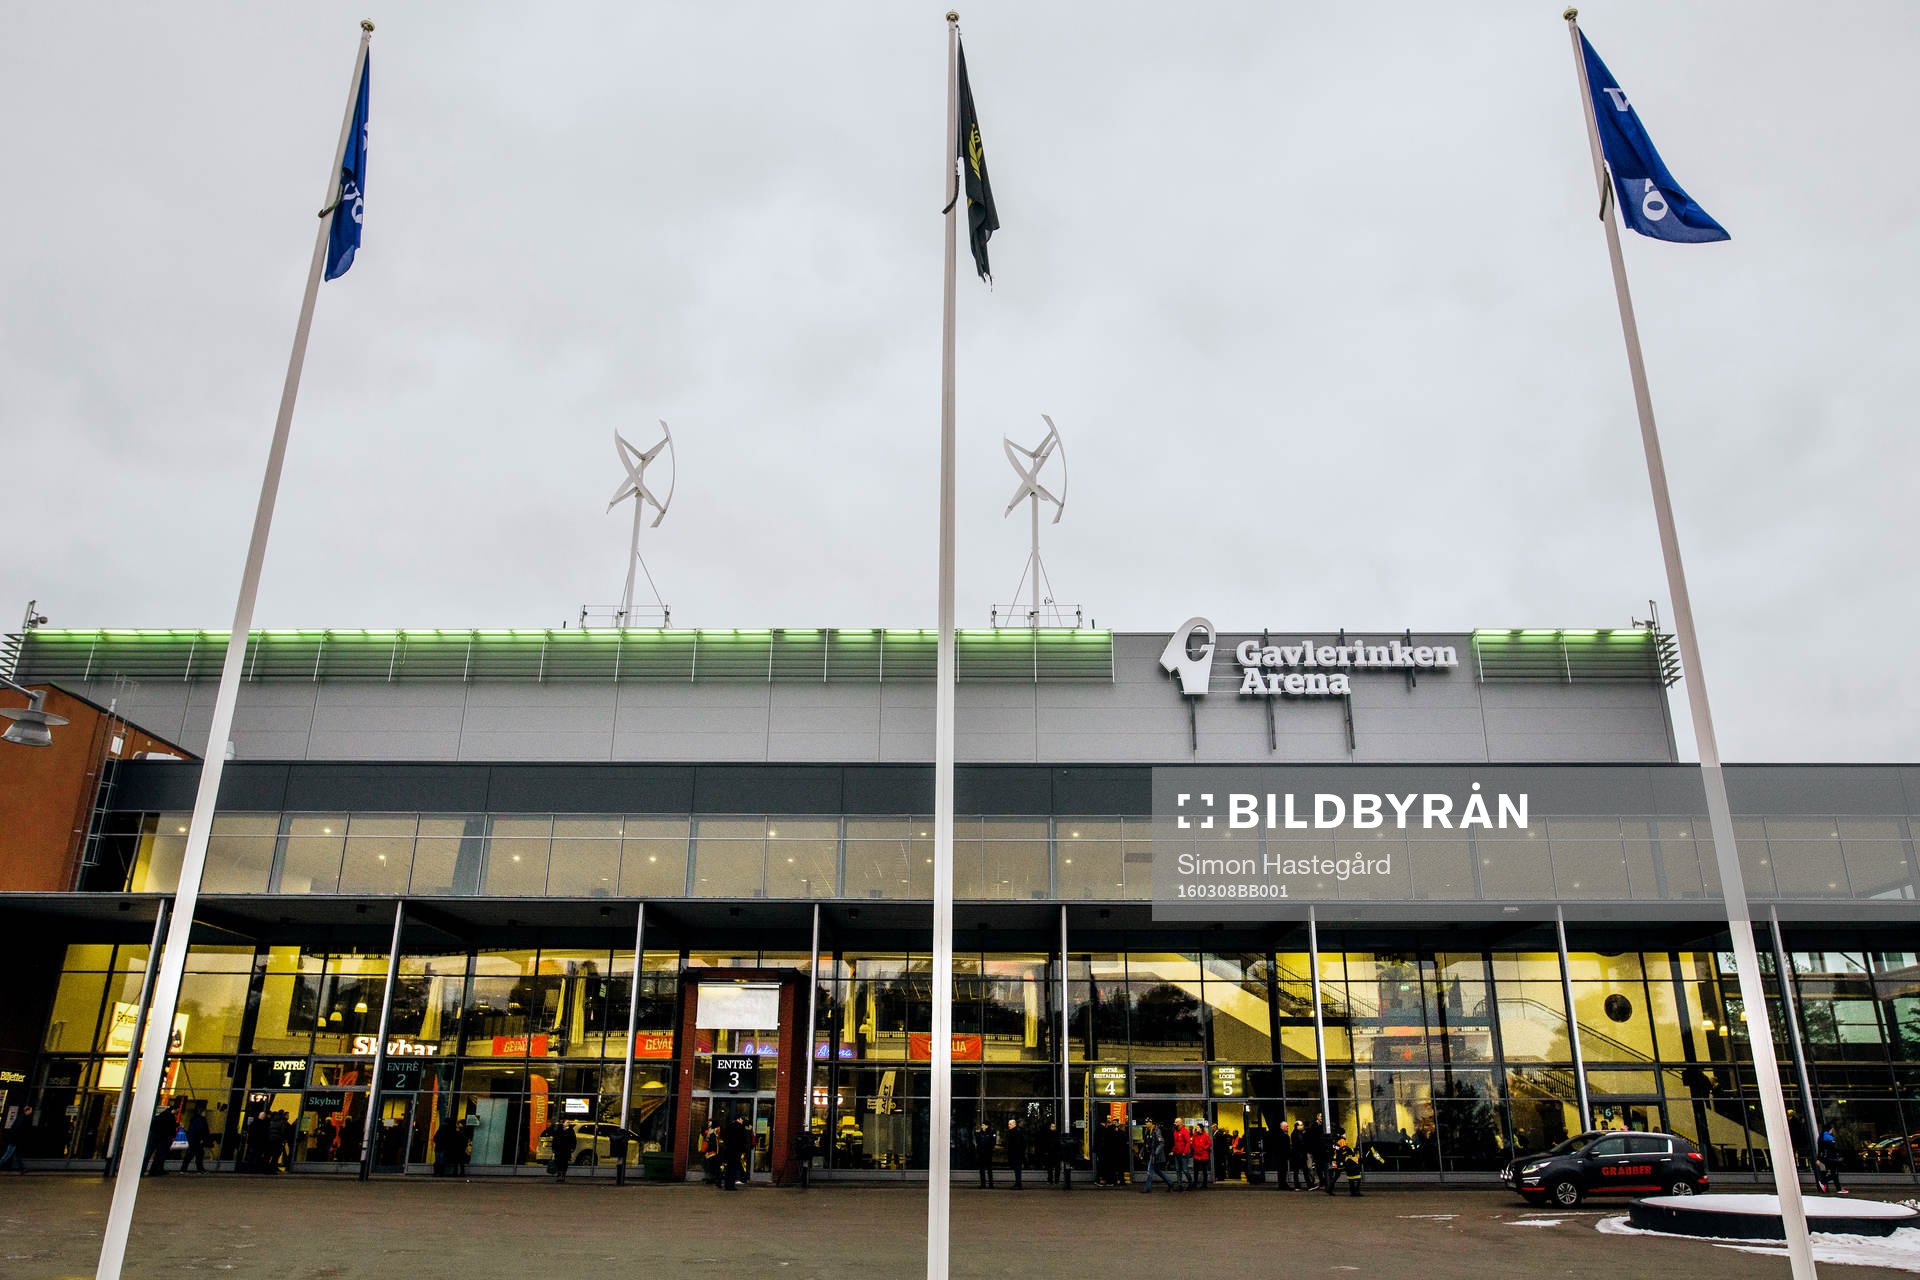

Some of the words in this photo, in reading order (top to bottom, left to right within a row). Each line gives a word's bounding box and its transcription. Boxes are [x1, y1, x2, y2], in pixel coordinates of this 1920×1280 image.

[1236, 640, 1459, 667] Gavlerinken
[1240, 668, 1351, 694] Arena
[645, 1038, 673, 1050] GEVAL
[817, 1044, 853, 1058] Arna
[282, 1071, 291, 1087] 1
[396, 1073, 406, 1088] 2
[728, 1072, 740, 1087] 3
[1105, 1080, 1115, 1095] 4
[1222, 1080, 1233, 1095] 5
[309, 1096, 340, 1106] Skybar
[1605, 1108, 1612, 1117] 6
[1601, 1165, 1653, 1176] GRABBER
